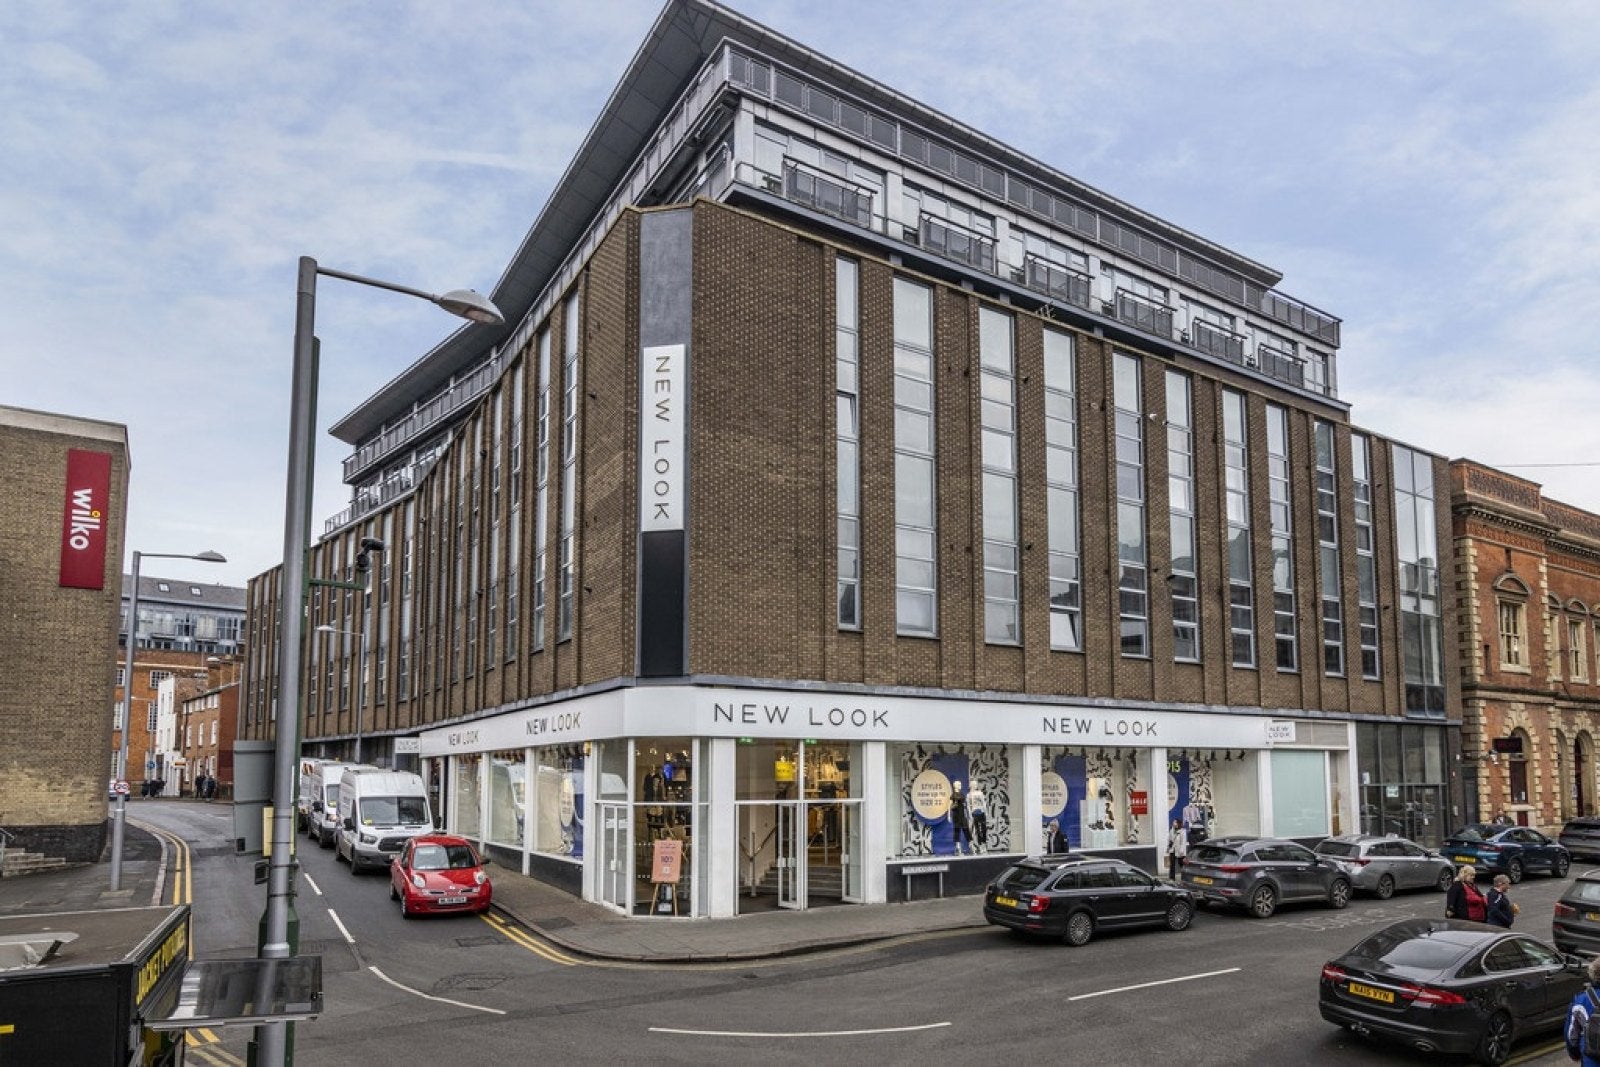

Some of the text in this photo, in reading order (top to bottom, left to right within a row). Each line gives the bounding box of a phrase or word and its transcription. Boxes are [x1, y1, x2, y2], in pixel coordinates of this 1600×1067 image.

[654, 356, 670, 519] NEW LOOK
[69, 488, 100, 550] wilko
[526, 712, 581, 735] NEW LOOK
[714, 703, 889, 727] NEW LOOK
[1043, 717, 1157, 736] NEW LOOK
[449, 730, 479, 747] NEW LOOK
